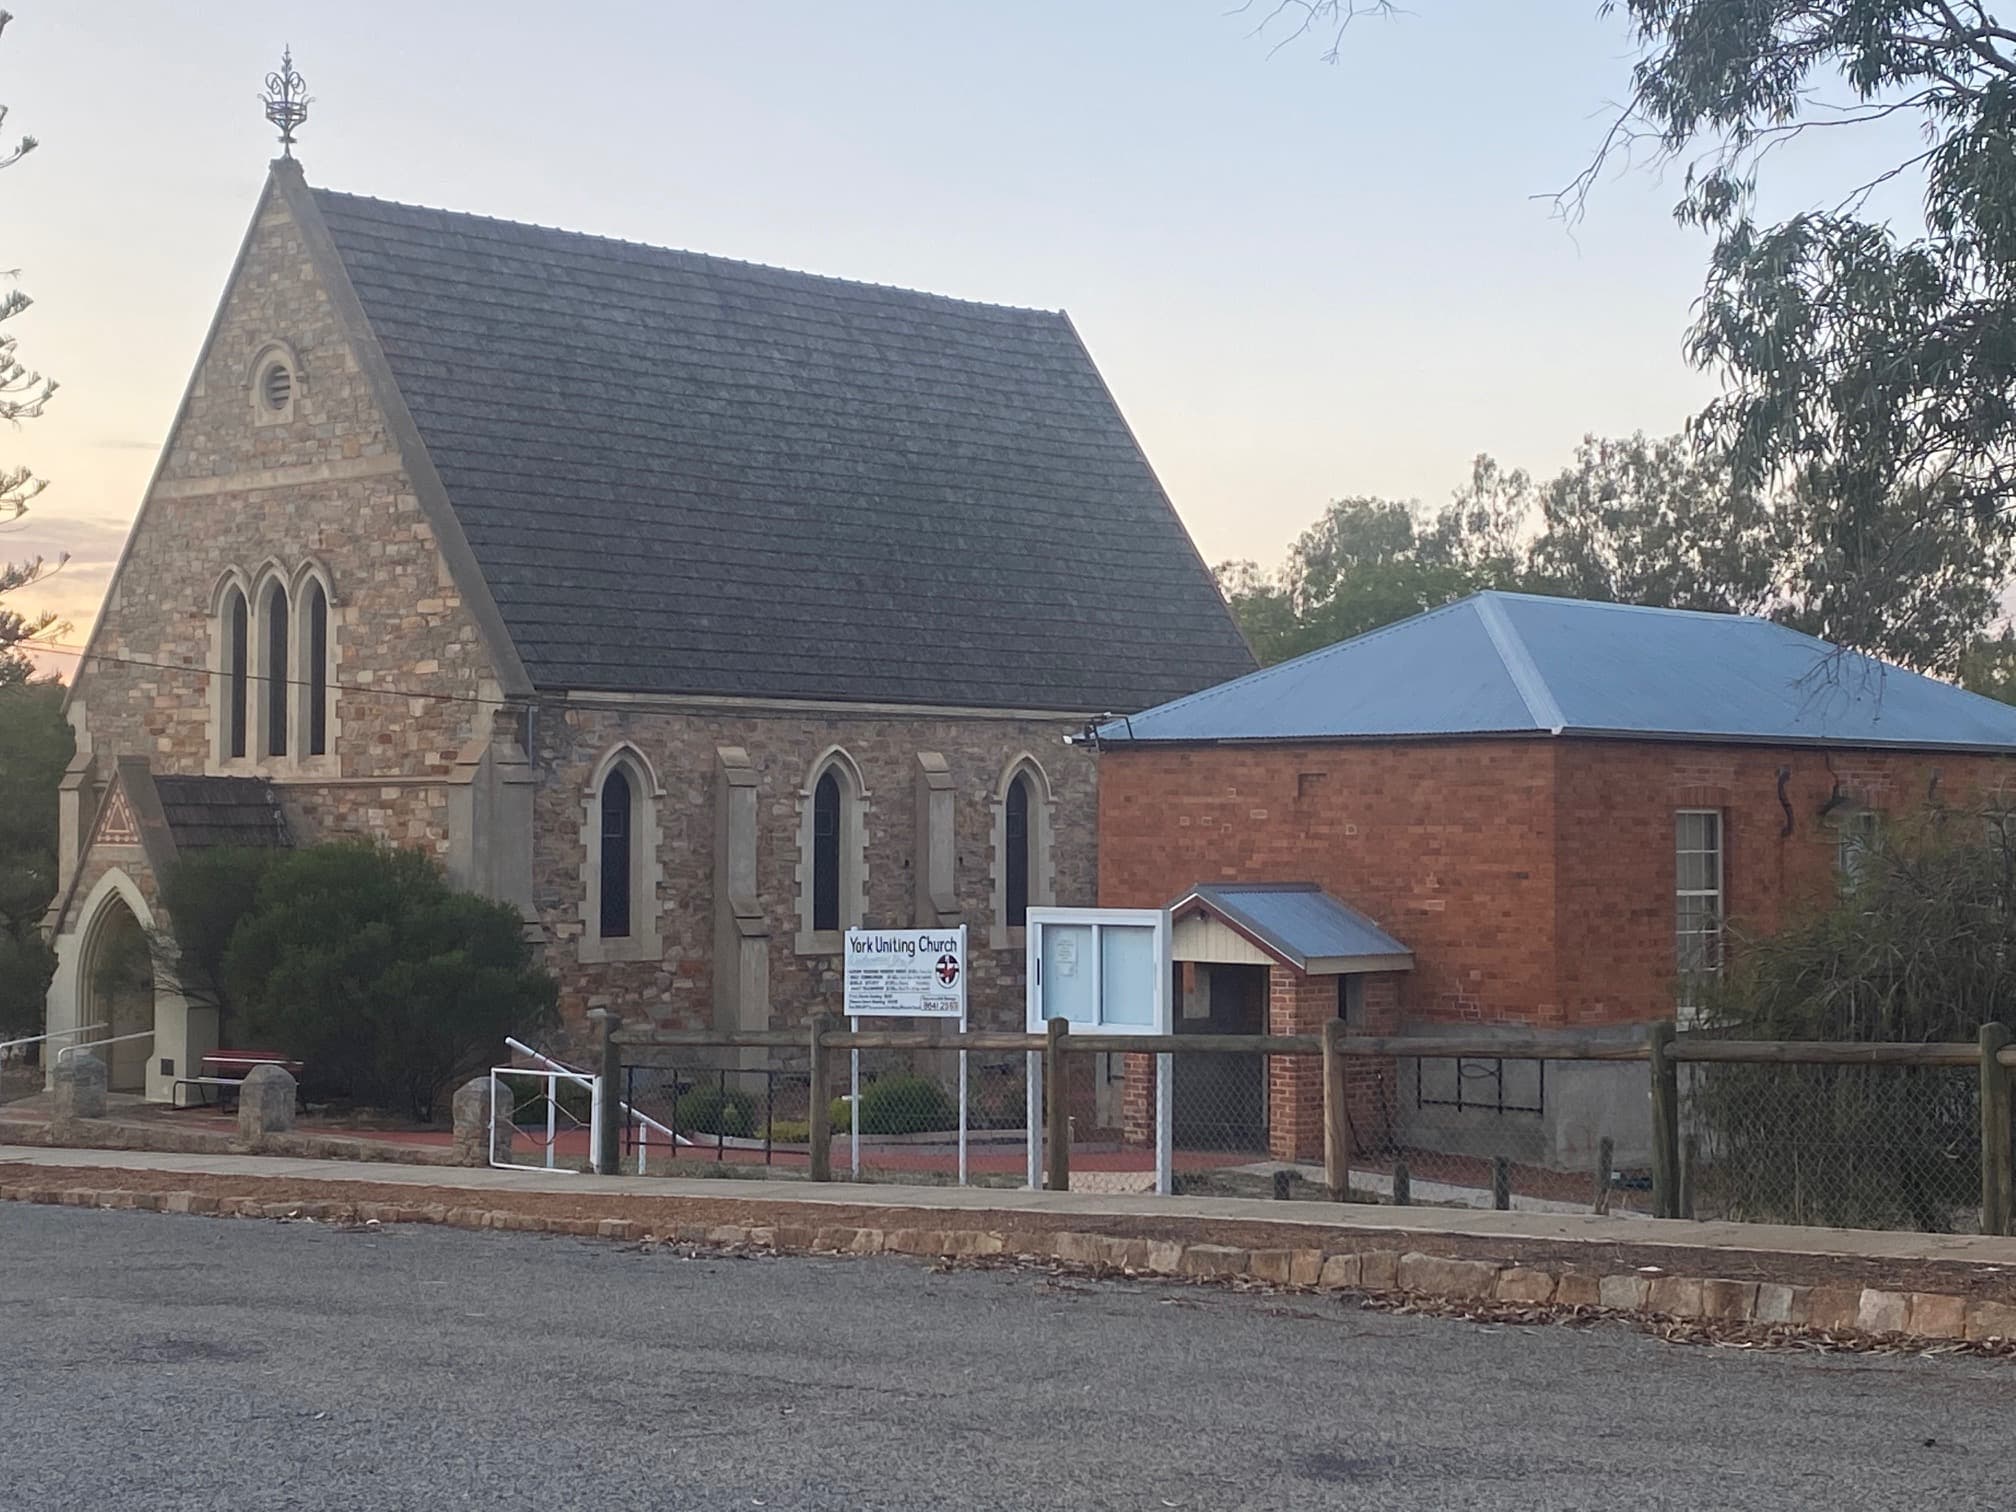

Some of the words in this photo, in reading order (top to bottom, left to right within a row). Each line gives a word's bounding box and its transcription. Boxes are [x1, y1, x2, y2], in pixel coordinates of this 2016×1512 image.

[850, 936, 873, 953] York
[875, 936, 916, 958] Uniting
[918, 935, 957, 952] Church
